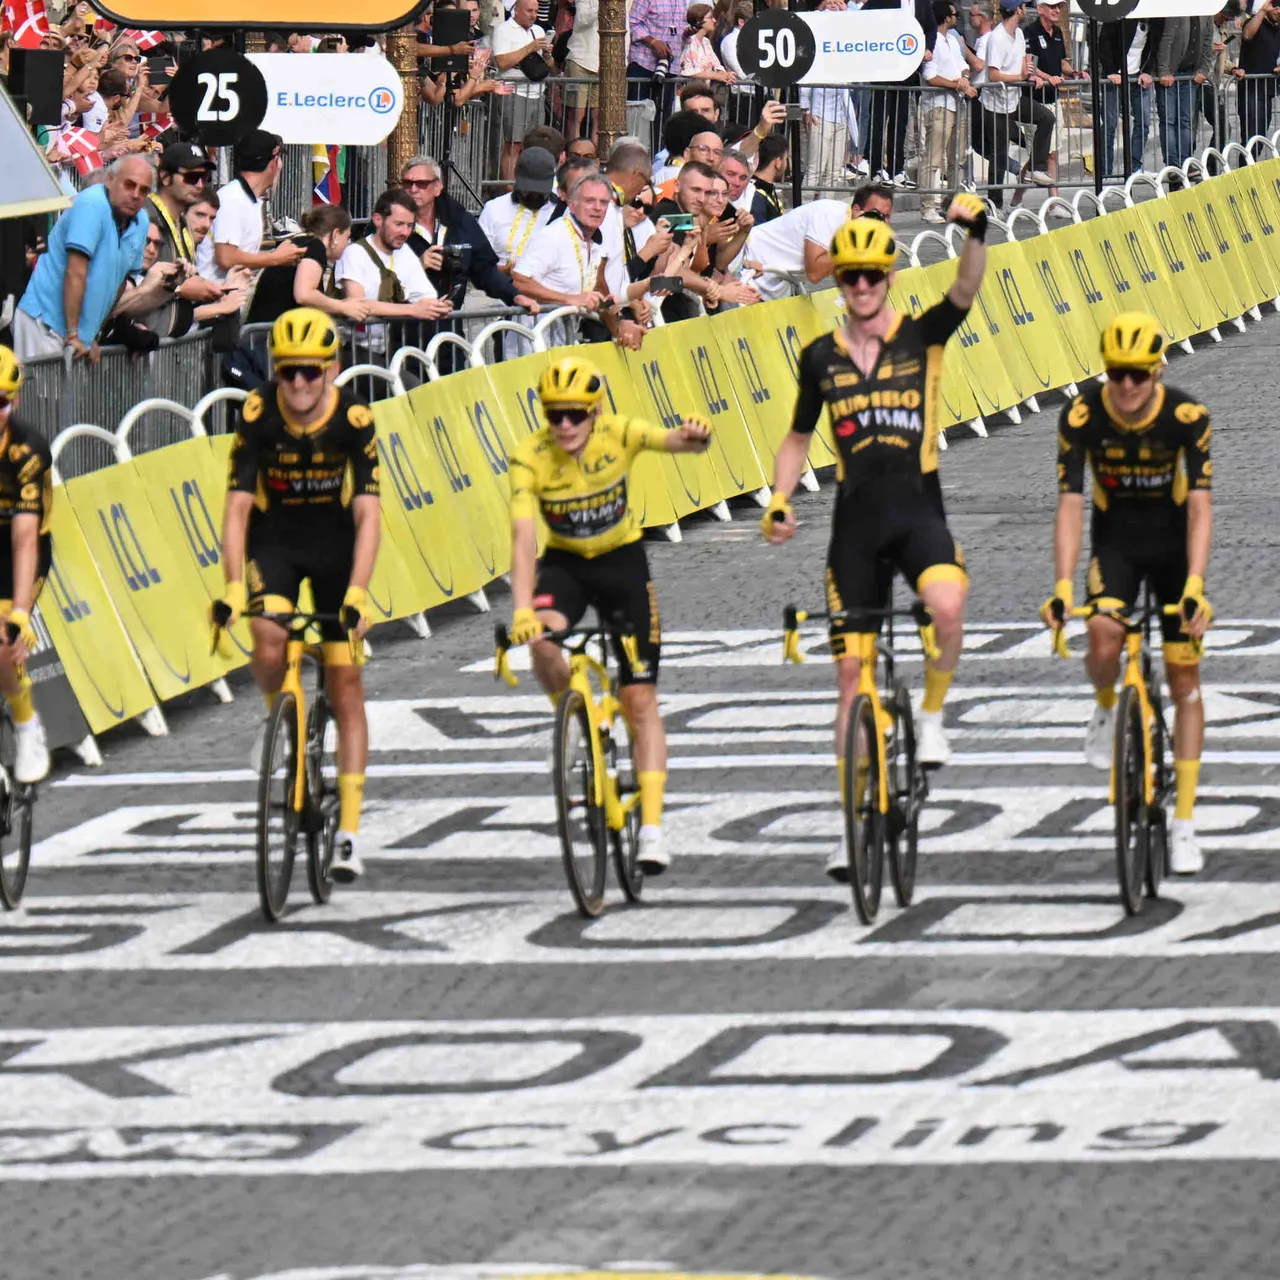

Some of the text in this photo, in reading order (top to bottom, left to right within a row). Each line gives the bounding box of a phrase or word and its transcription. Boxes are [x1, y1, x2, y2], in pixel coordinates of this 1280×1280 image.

[757, 28, 894, 69] 50 E.Leclerc
[196, 73, 366, 122] 25 E.Leclerc
[1182, 211, 1212, 263] LCL
[1226, 194, 1253, 244] LCL
[1247, 187, 1275, 236] LCL
[1099, 239, 1131, 293] LCL
[1124, 230, 1157, 284] LCL
[1153, 220, 1185, 273] LCL
[996, 268, 1035, 325] LCL
[1036, 259, 1070, 314] LCL
[1068, 248, 1103, 304] LCL
[643, 359, 682, 429] LCL
[690, 346, 728, 415] LCL
[733, 337, 770, 404] LCL
[466, 400, 510, 475] LCL
[857, 408, 922, 433] VISMA
[377, 432, 434, 512] LCL
[428, 415, 472, 493] LCL
[98, 503, 161, 592] LCL
[421, 1117, 1231, 1157] Cycling
